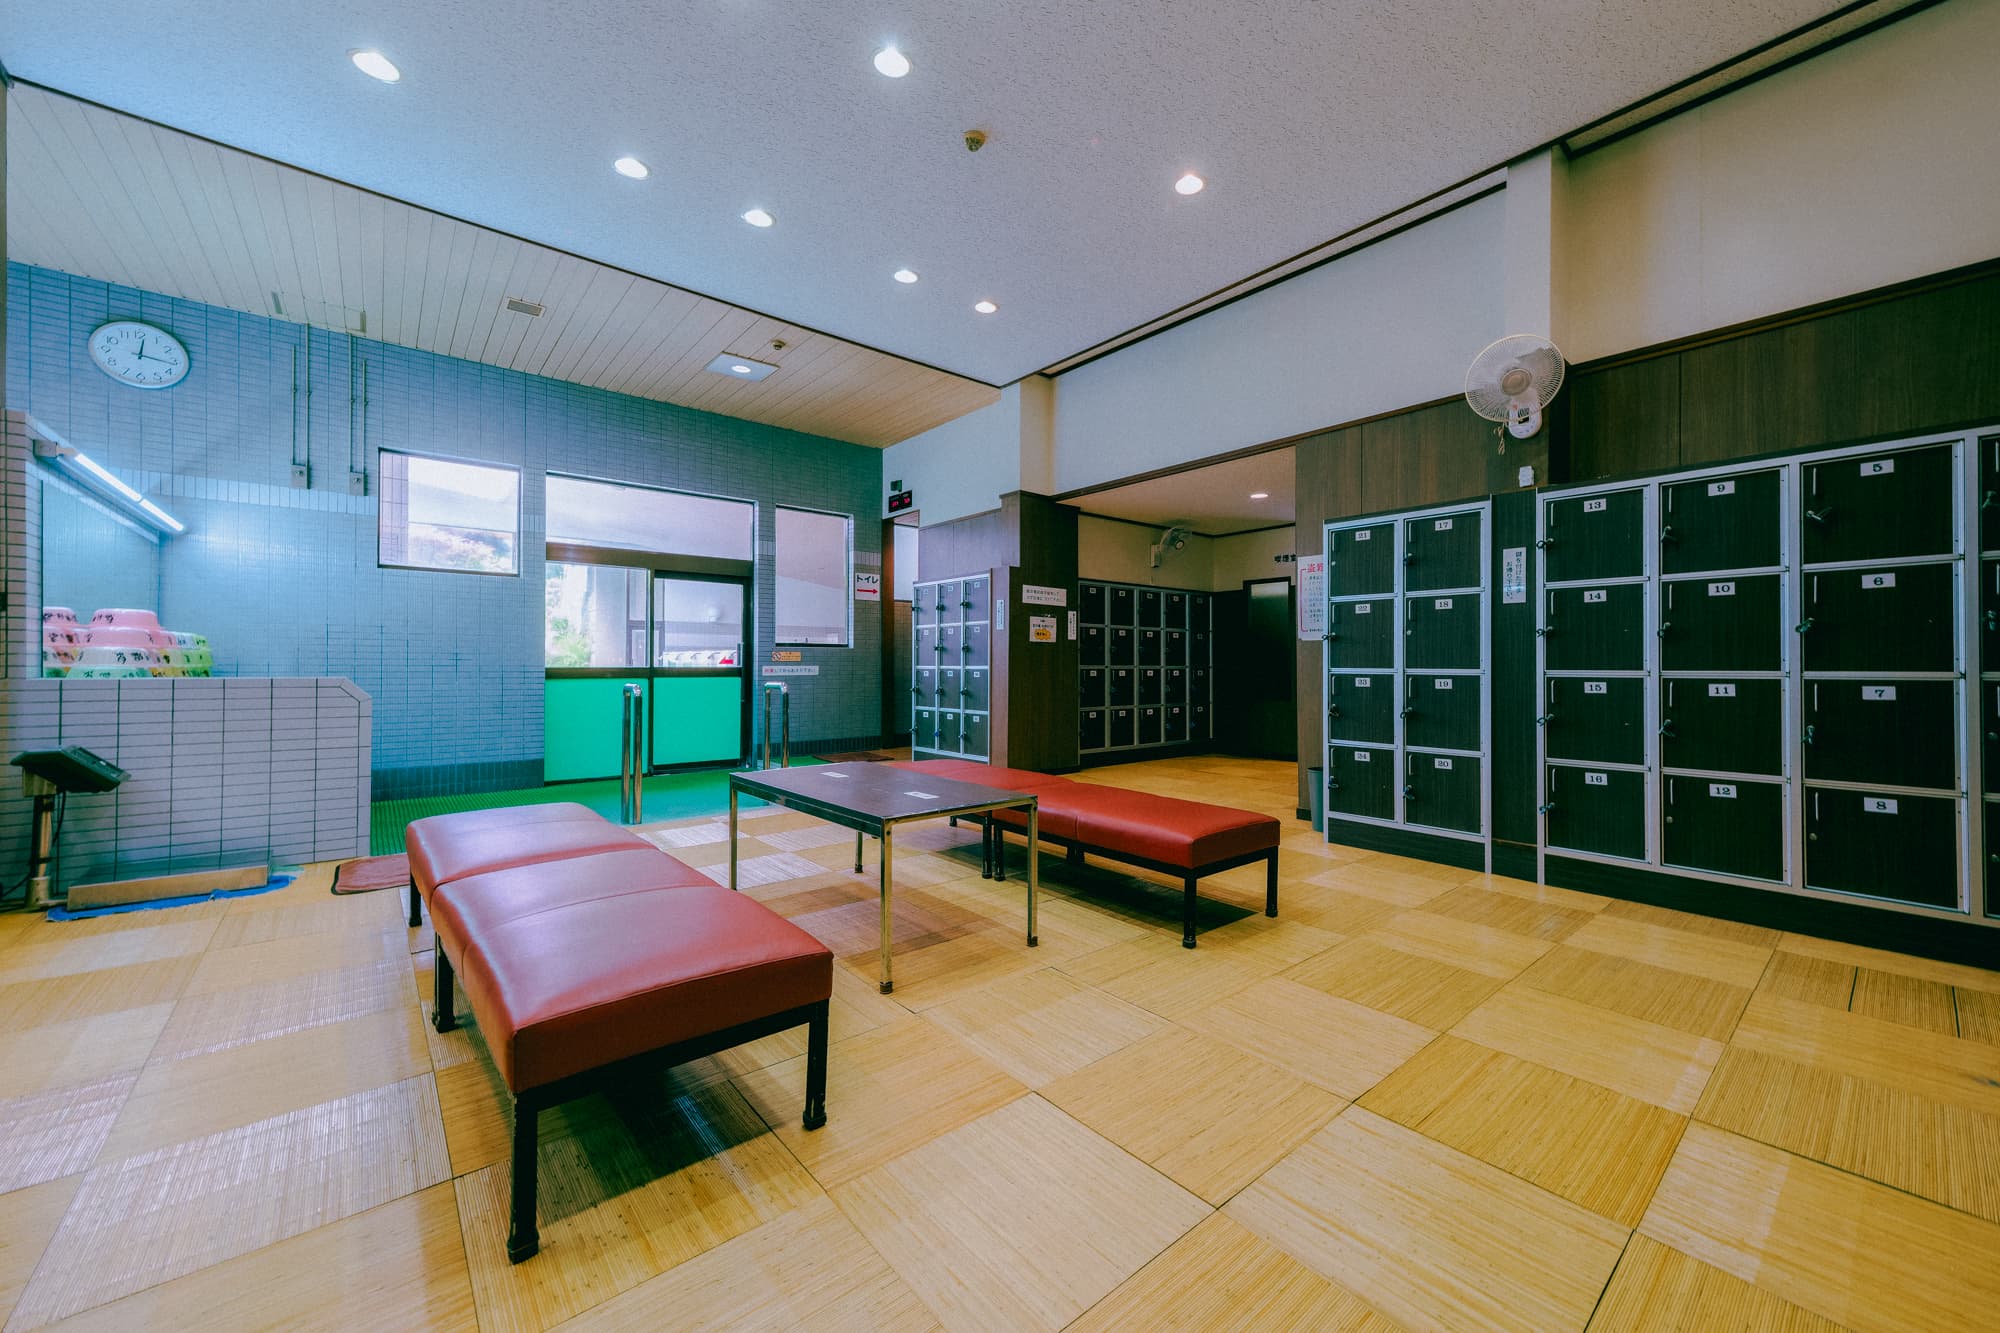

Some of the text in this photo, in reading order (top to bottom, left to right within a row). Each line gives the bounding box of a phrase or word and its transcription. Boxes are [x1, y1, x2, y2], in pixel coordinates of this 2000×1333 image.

[120, 330, 129, 339] 11
[134, 330, 146, 339] 12
[106, 336, 118, 344] 10
[100, 345, 111, 353] 9
[163, 346, 172, 354] 2
[108, 357, 116, 366] 8
[136, 372, 146, 380] 6
[153, 372, 162, 380] 5
[856, 574, 878, 584] トイレ
